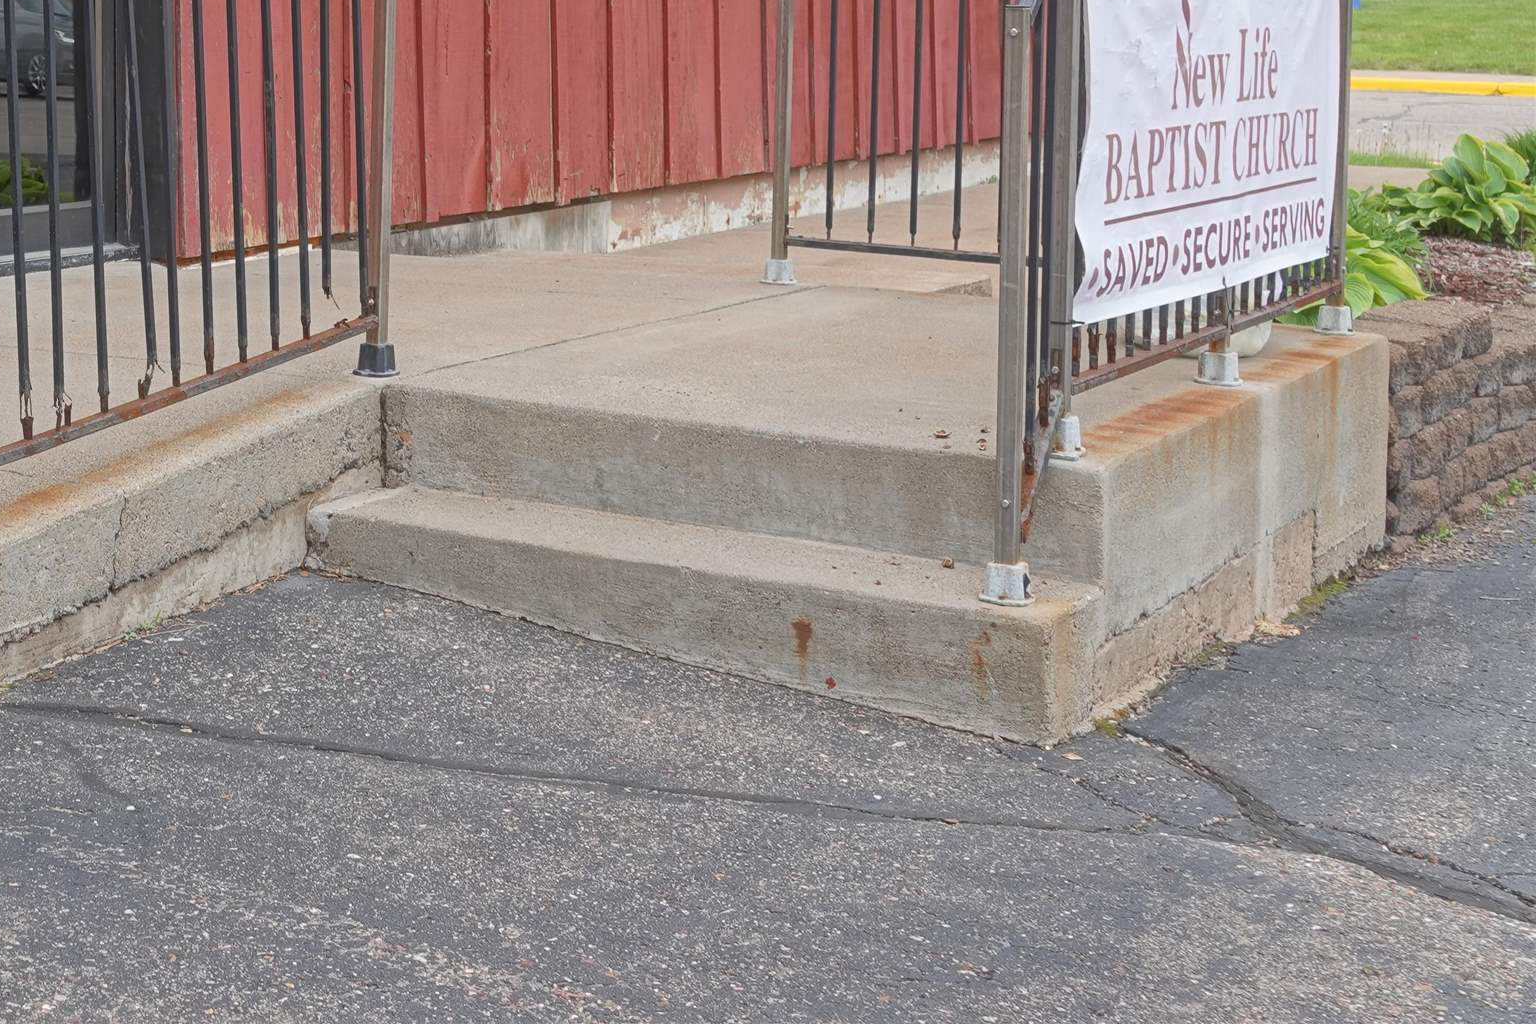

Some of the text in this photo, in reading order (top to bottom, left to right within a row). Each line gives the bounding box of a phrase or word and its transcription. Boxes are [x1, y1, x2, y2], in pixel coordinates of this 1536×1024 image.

[1171, 24, 1278, 110] New Life
[1104, 108, 1318, 204] BAPTIST CHURCH
[1096, 197, 1325, 298] SAVED SECURE SERVING
